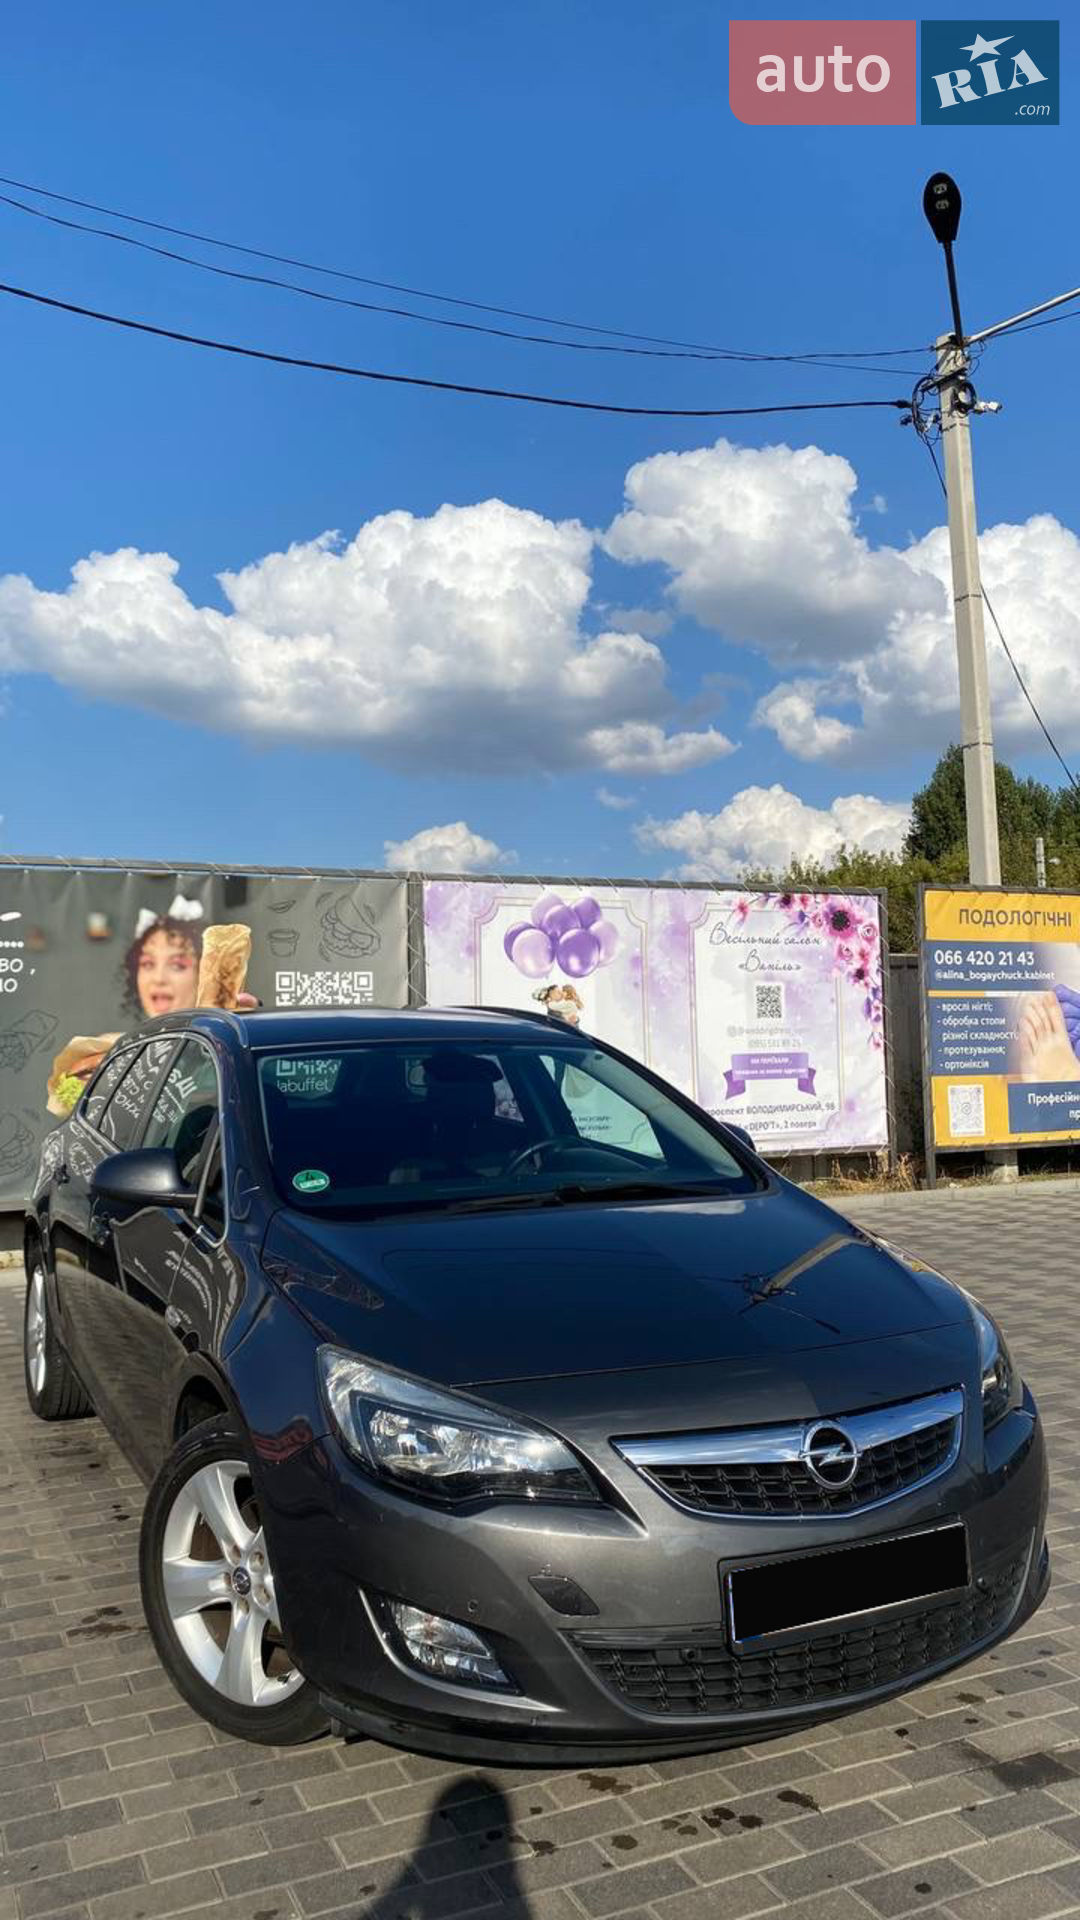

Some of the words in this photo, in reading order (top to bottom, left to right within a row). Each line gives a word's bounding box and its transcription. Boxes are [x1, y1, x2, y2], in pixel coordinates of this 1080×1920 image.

[959, 908, 1072, 928] ПОДОЛОГІЧНІ
[934, 950, 962, 965] 066
[966, 951, 995, 966] 420
[998, 951, 1013, 966] 21
[1017, 951, 1035, 966] 43
[942, 1015, 979, 1028] обробка
[980, 1017, 1006, 1026] стопи
